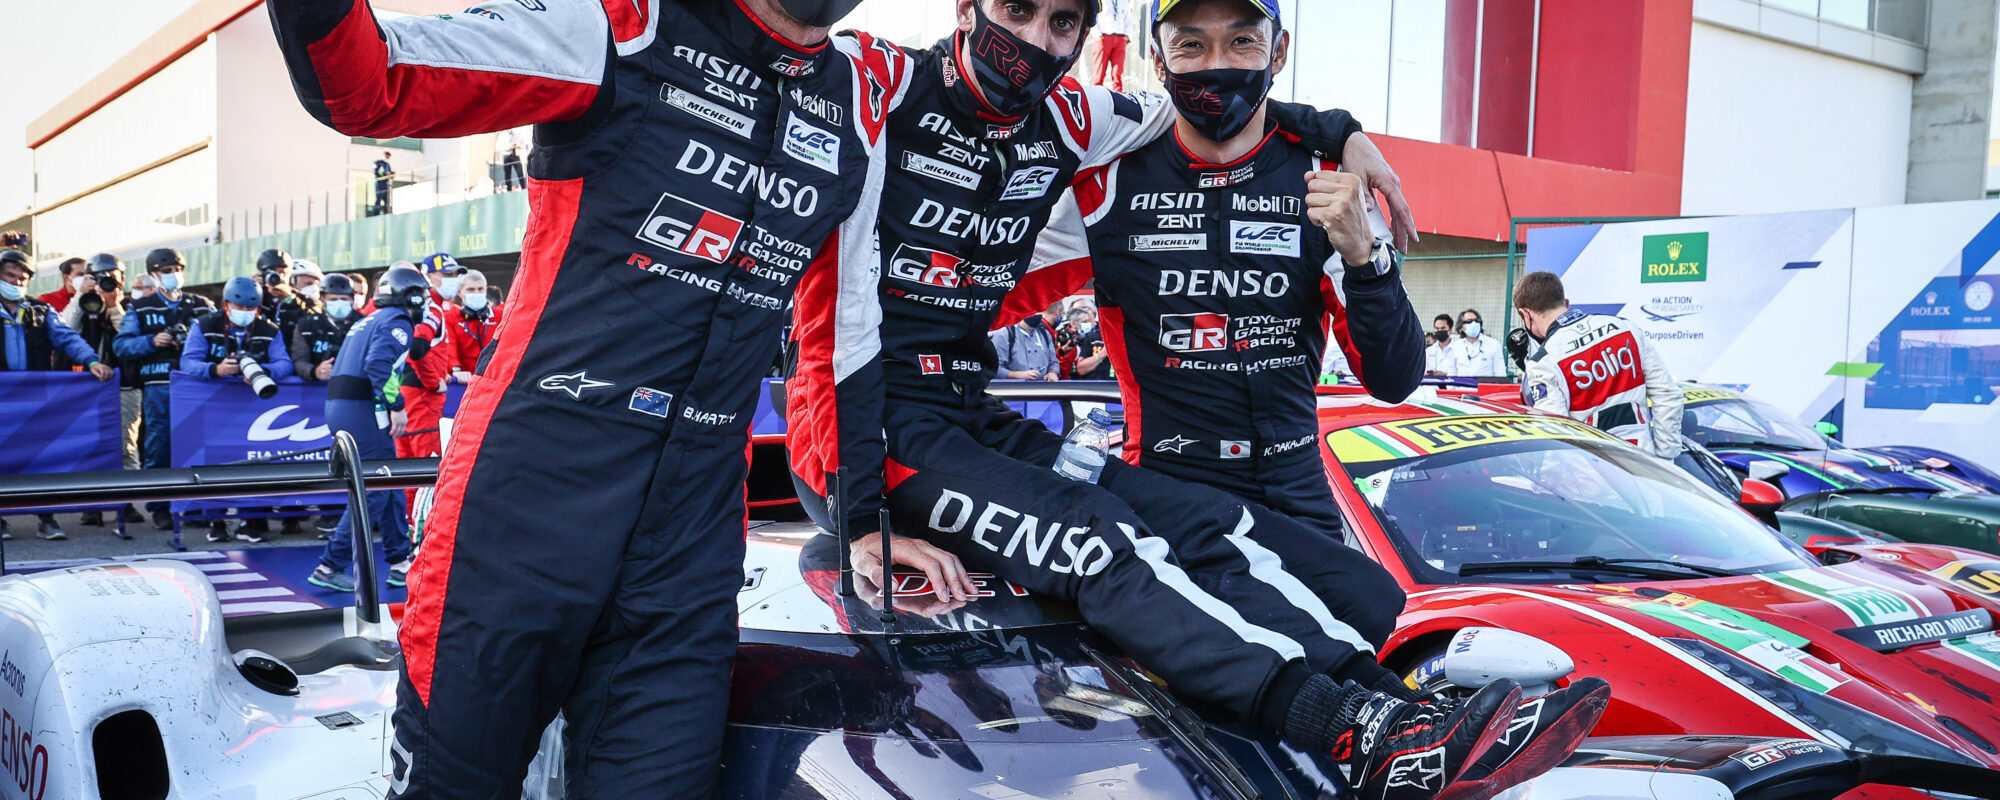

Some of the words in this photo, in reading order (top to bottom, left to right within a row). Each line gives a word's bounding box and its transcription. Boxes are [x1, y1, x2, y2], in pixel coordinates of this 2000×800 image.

[673, 45, 762, 91] AISIN
[704, 77, 758, 111] ZENT
[790, 87, 827, 118] Mobil
[686, 100, 745, 130] MICHELIN
[788, 124, 837, 154] WEC
[918, 112, 988, 152] AIS
[937, 142, 990, 170] ZENT
[675, 139, 818, 217] DENSO
[924, 164, 974, 183] MICHELIN
[1009, 169, 1054, 188] WEC
[1200, 177, 1227, 187] GR
[1130, 192, 1205, 211] AISIN
[1232, 192, 1280, 213] Mobil
[909, 198, 1031, 245] DENSO
[1157, 213, 1205, 229] ZENT
[458, 233, 488, 251] ROLEX
[644, 215, 731, 261] GR
[754, 225, 812, 260] TOYOTA
[1150, 238, 1200, 246] MICHELIN
[1235, 226, 1297, 242] WEC
[748, 241, 803, 271] GAZOO
[626, 252, 723, 293] RACING
[738, 257, 792, 286] Racing
[892, 258, 958, 288] GR
[973, 271, 1012, 284] AZOO
[1647, 261, 1700, 277] ROLEX
[1158, 269, 1290, 298] DENSO
[886, 288, 967, 309] RACING
[1663, 296, 1692, 304] ACTION
[145, 314, 166, 325] 114
[1235, 315, 1302, 328] TOYOTA
[1910, 306, 1951, 316] ROLEX
[1161, 327, 1225, 350] GR
[1233, 335, 1296, 352] Racing
[1234, 326, 1296, 340] GAZOO
[1565, 323, 1620, 354] JOTA
[1165, 357, 1239, 372] RACING
[1246, 355, 1307, 375] HYBRID
[247, 451, 272, 461] FIA
[928, 488, 1113, 577] DENSO
[1874, 621, 1945, 645] RICHARD
[1945, 615, 1984, 634] MILLE
[0, 649, 26, 698] Acronis
[1, 708, 49, 800] ENSO
[1742, 748, 1782, 768] GR
[1784, 746, 1823, 757] Racing
